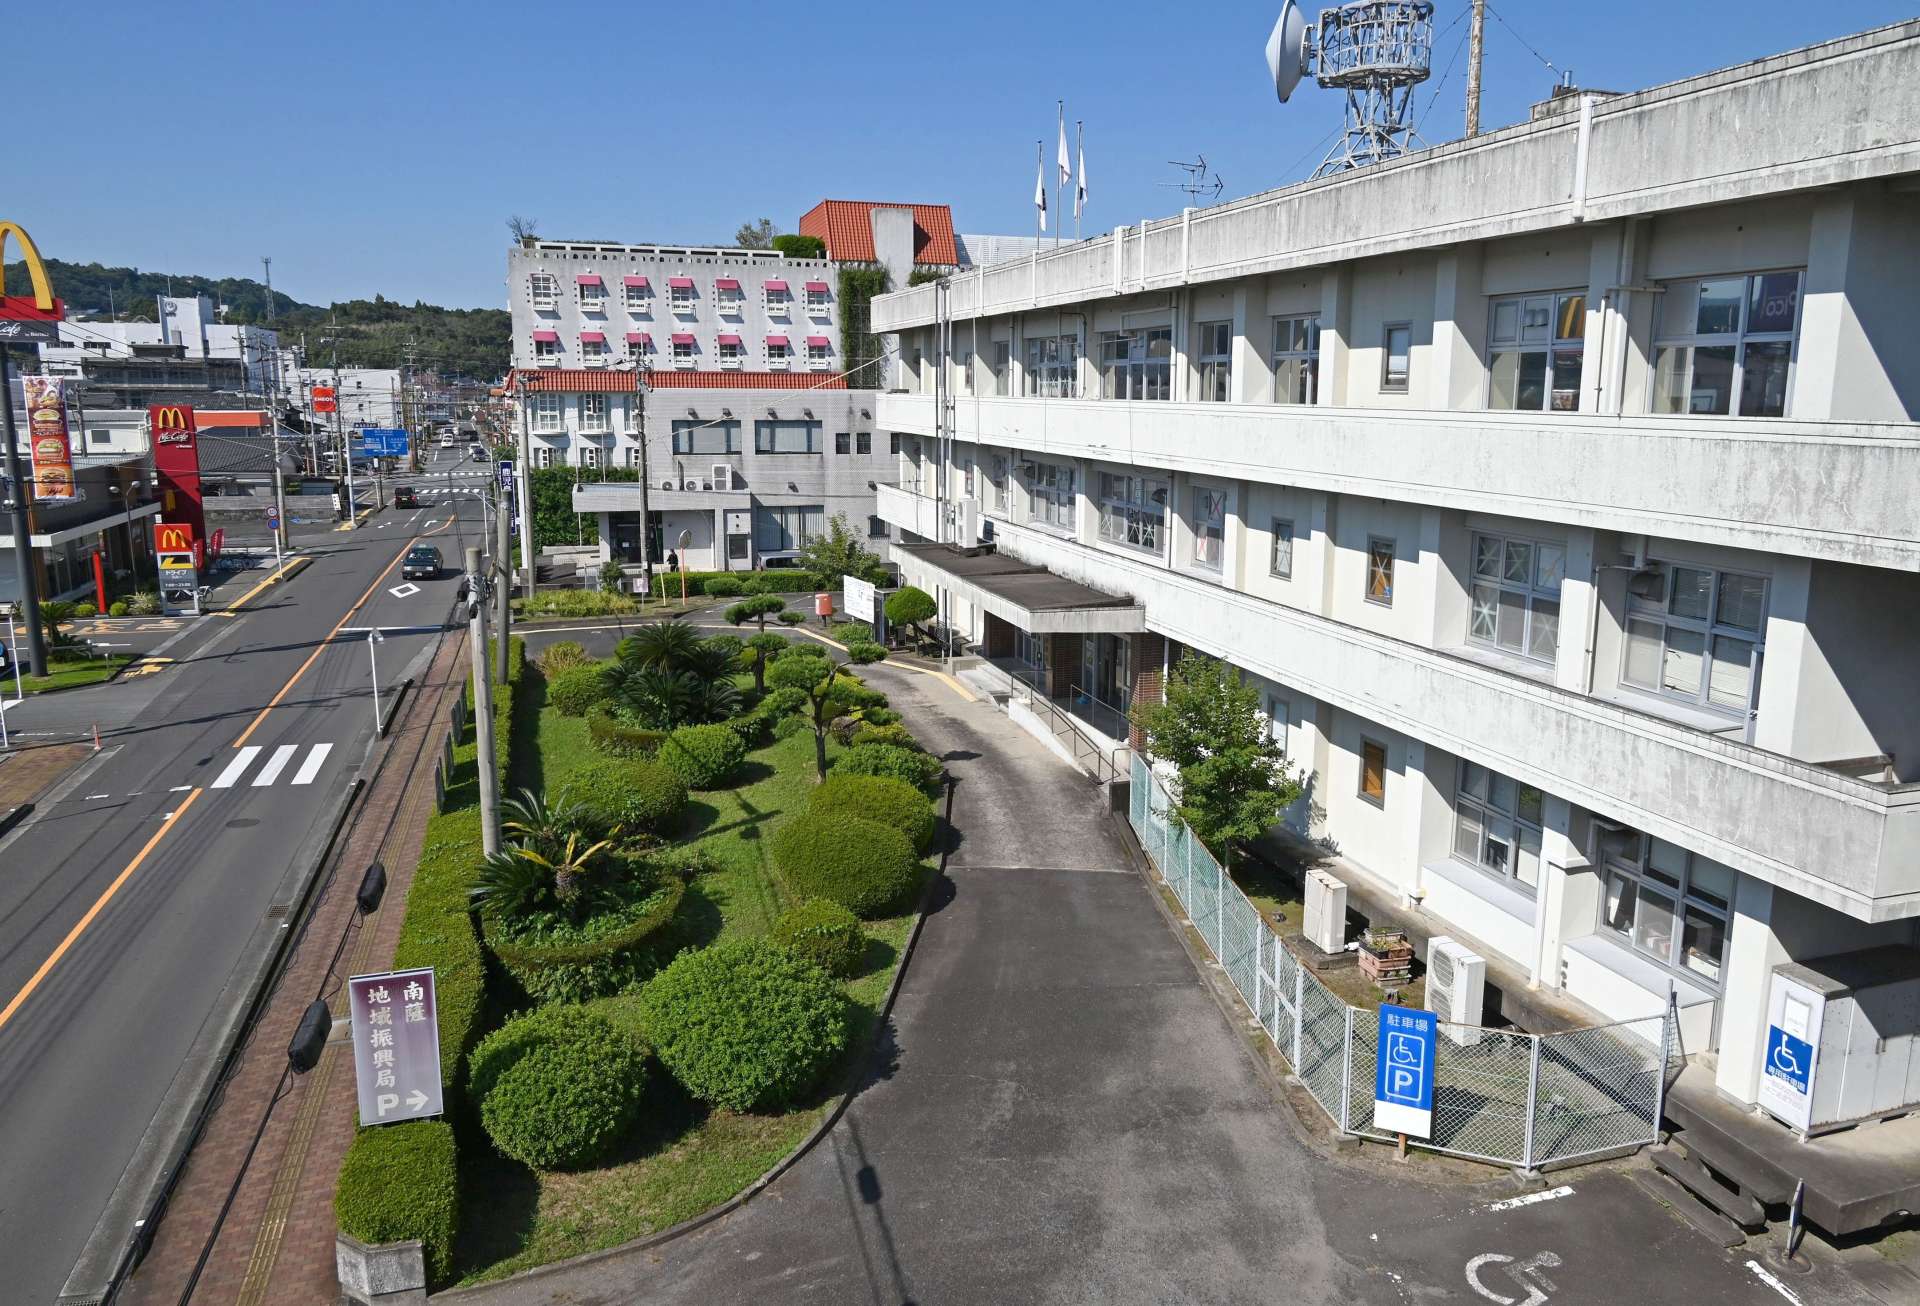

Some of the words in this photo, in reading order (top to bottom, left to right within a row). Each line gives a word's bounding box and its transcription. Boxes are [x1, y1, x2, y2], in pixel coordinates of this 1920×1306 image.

[403, 981, 427, 1023] 南薩
[1387, 1013, 1428, 1033] 駐車場
[367, 985, 396, 1088] 地域振興局
[1394, 1069, 1413, 1093] P
[377, 1093, 399, 1117] P
